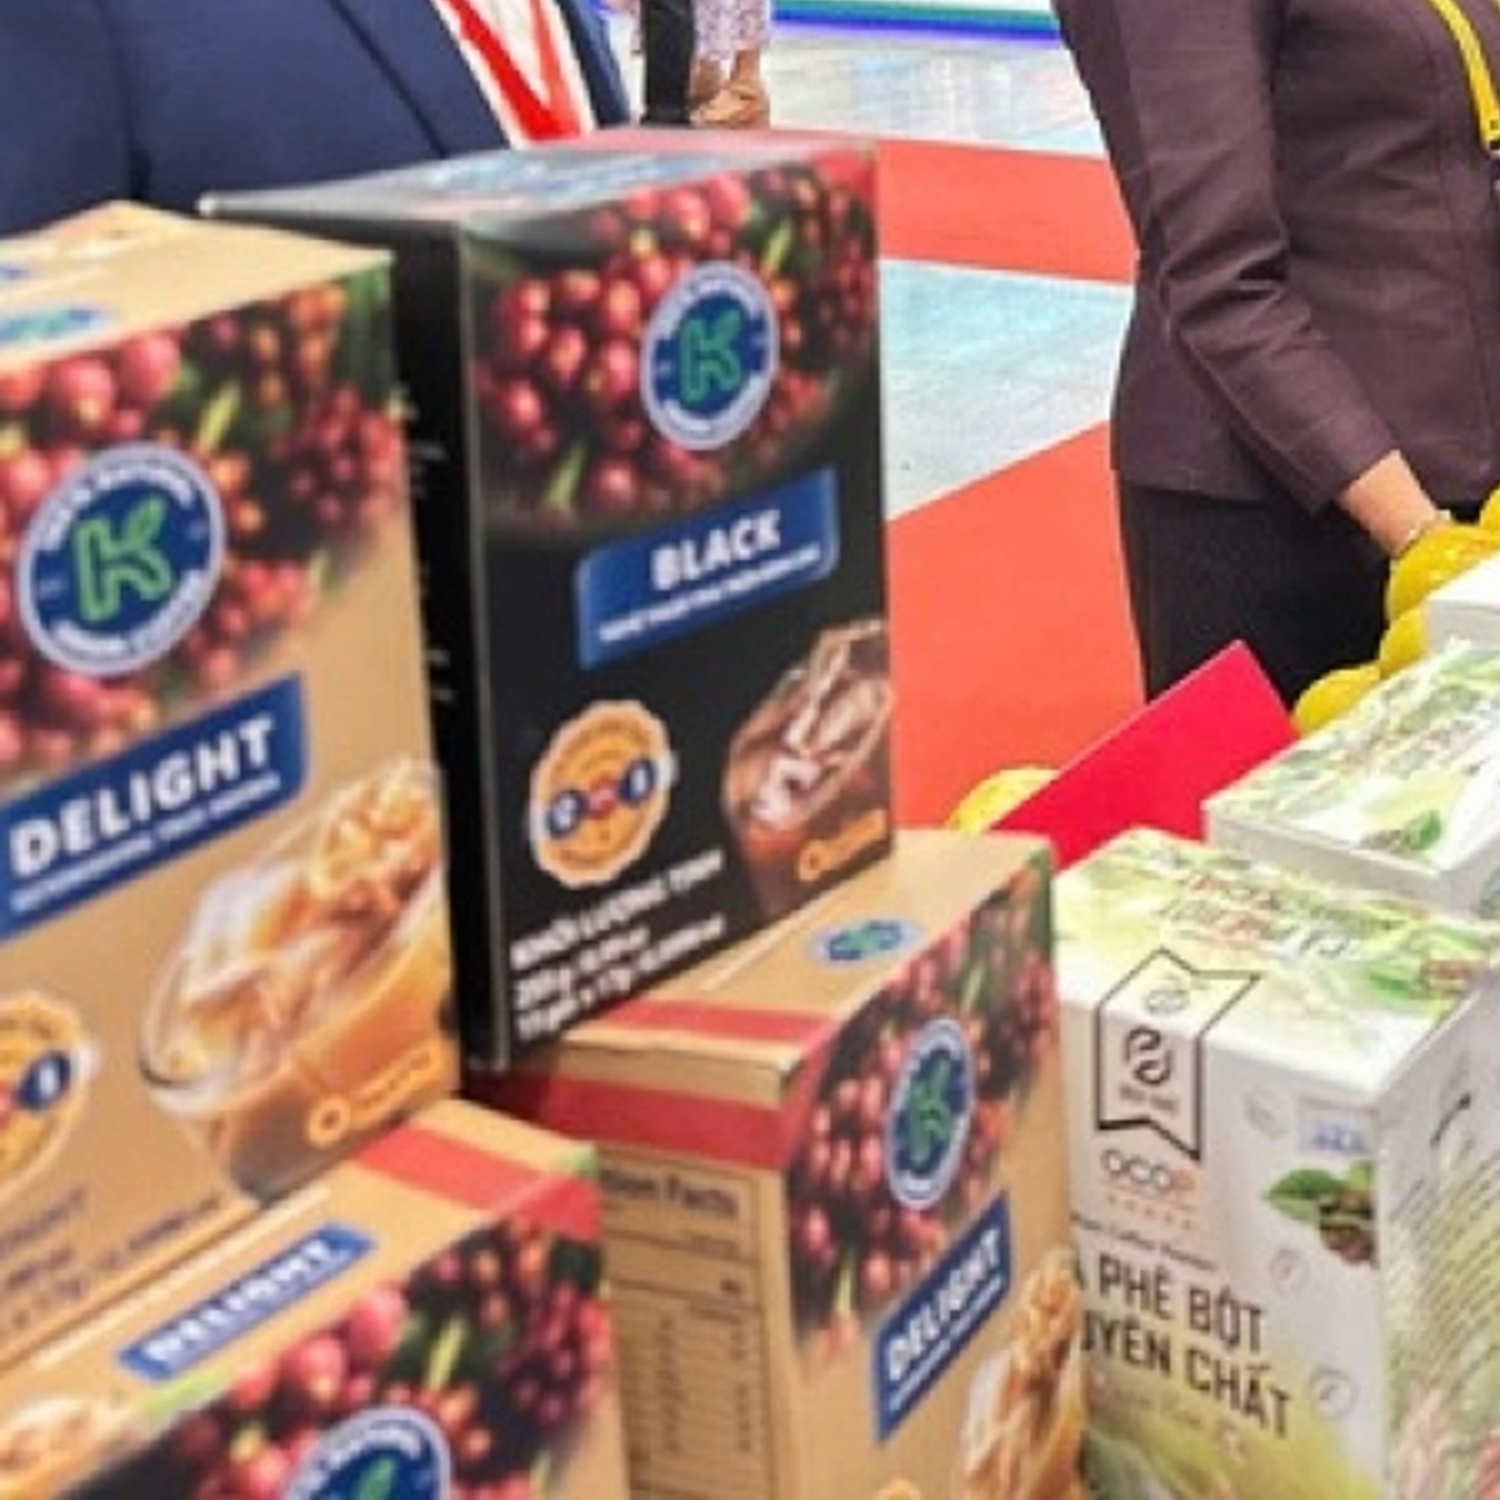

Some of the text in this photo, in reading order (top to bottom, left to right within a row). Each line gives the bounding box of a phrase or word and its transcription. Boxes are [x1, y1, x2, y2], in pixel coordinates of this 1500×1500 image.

[652, 508, 781, 591] BLACK
[9, 713, 276, 878] DELIGHT
[143, 1237, 334, 1365] DELIGHT
[882, 1224, 1002, 1384] DELIGHT
[1098, 1250, 1267, 1356] PHÊ BỘT
[1186, 1347, 1290, 1440] CHẤT
